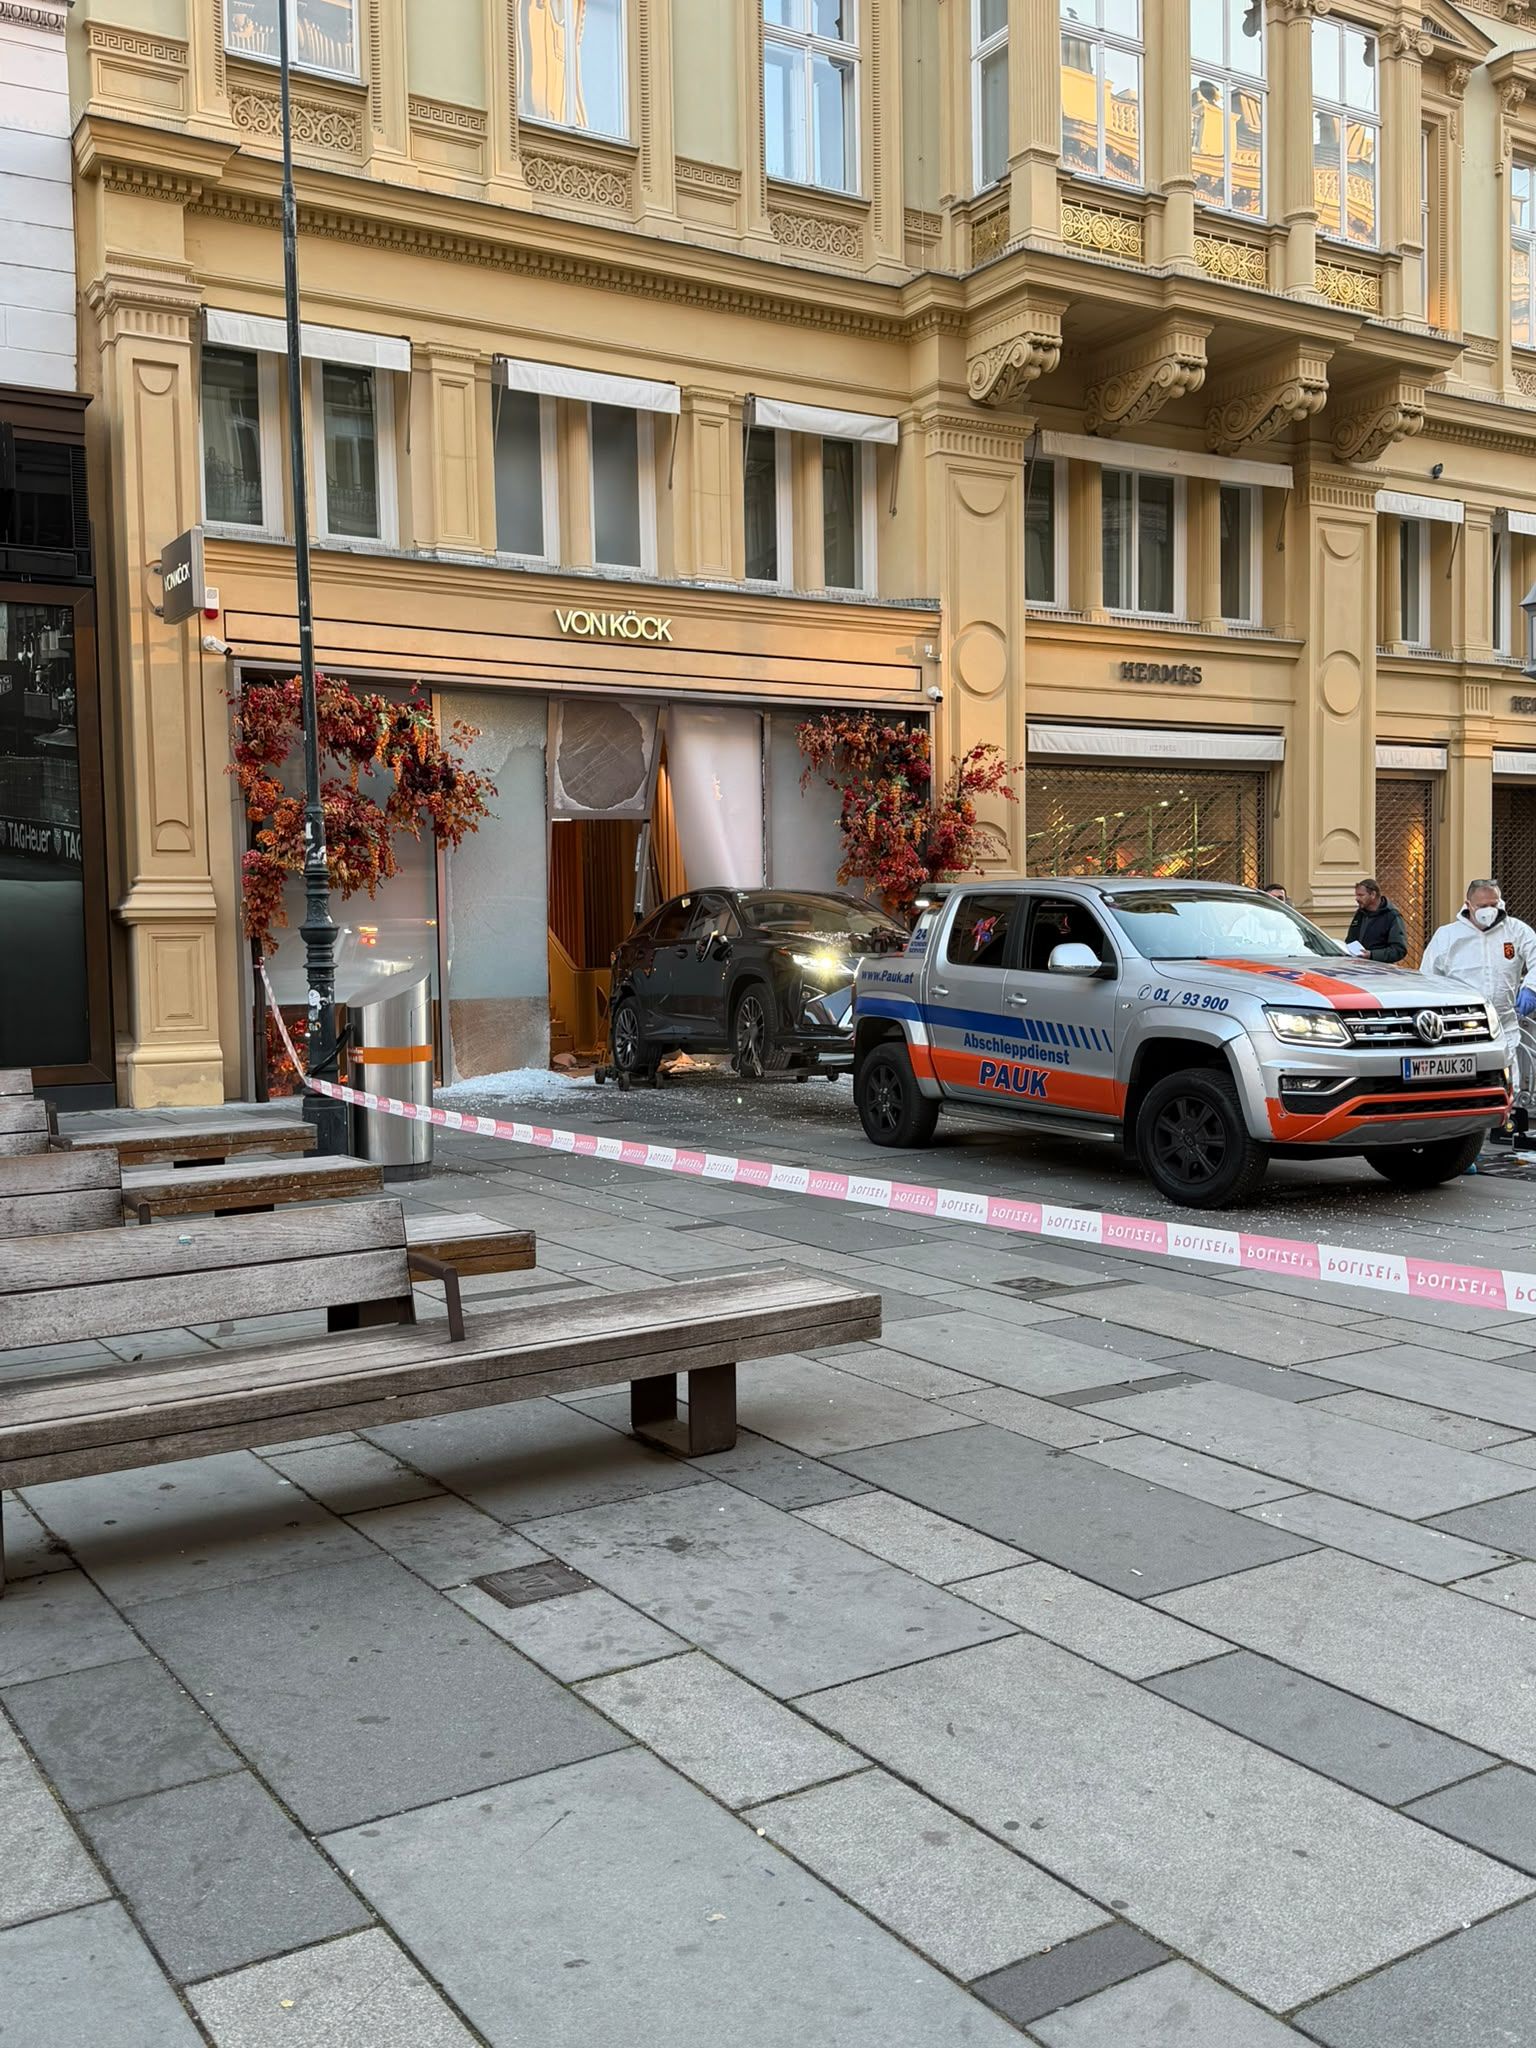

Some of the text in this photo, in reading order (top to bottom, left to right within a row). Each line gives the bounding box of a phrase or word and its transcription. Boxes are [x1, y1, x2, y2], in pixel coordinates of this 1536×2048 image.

[915, 929, 928, 940] 24
[862, 970, 914, 984] www.Pauk.at
[1153, 987, 1170, 1002] 01
[1182, 992, 1200, 1007] 93
[1201, 995, 1229, 1011] 900
[964, 1032, 1070, 1065] Abschleppdienst
[1412, 1061, 1421, 1076] W
[1459, 1058, 1473, 1073] 30
[978, 1059, 1050, 1098] PAUK
